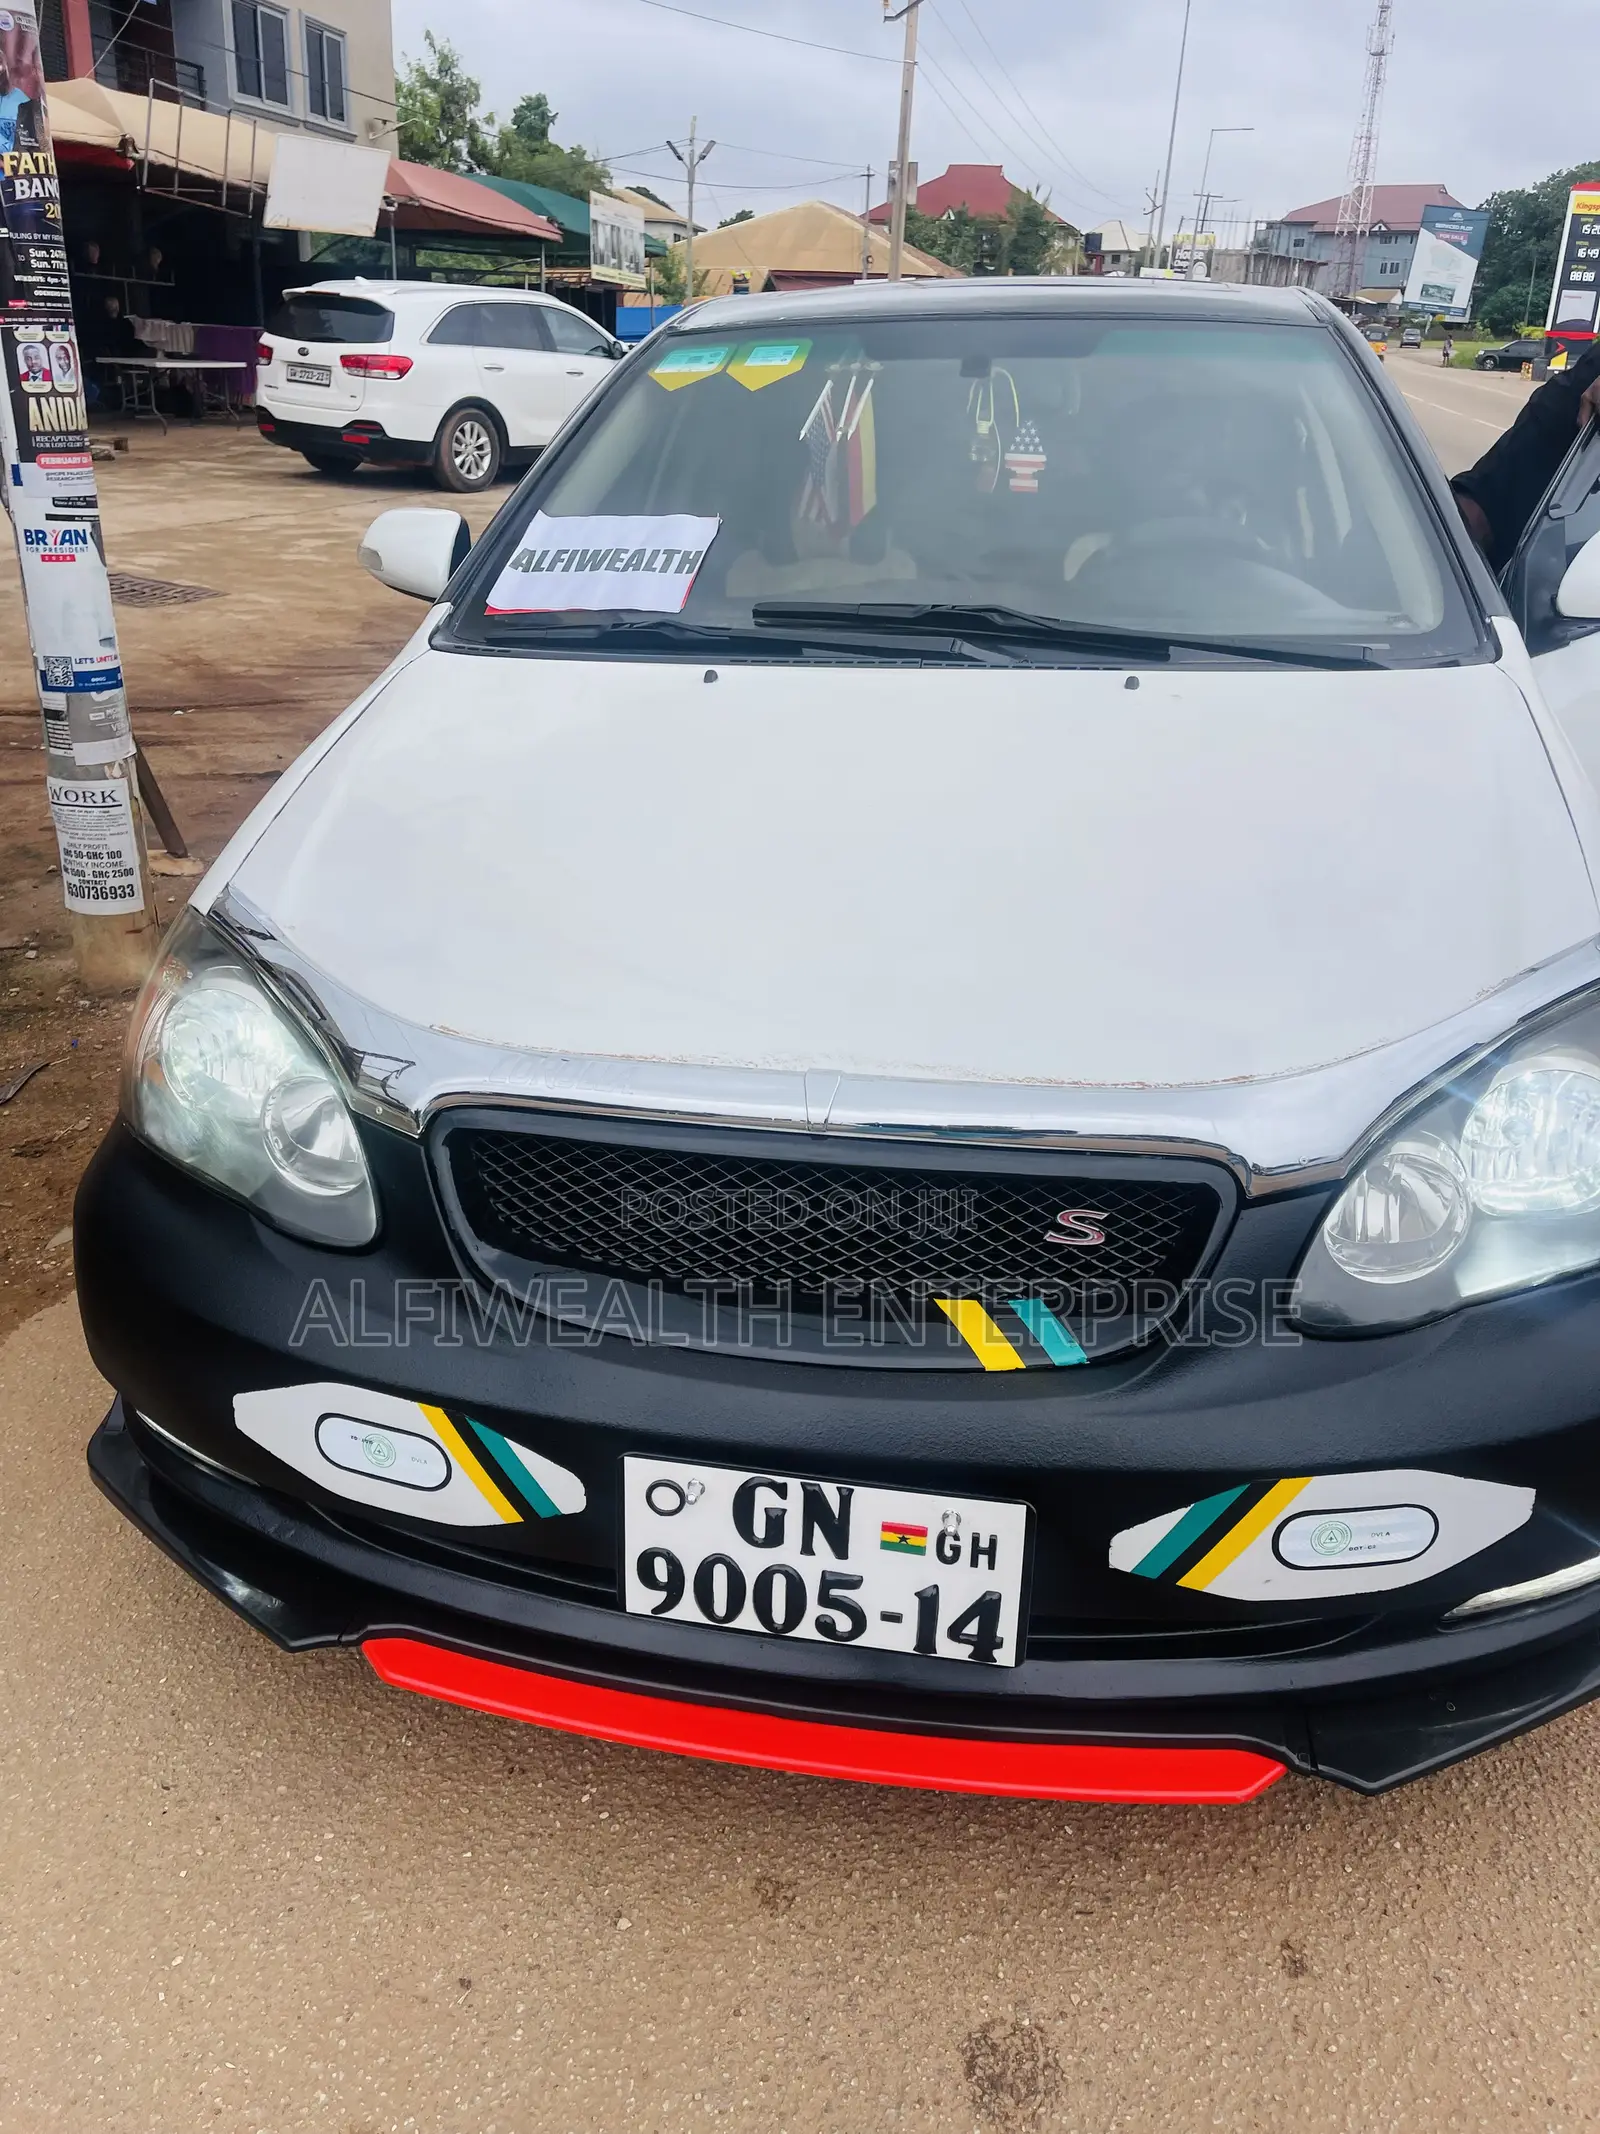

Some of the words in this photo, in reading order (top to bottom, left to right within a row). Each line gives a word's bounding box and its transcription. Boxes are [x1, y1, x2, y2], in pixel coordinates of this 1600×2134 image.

[23, 528, 88, 546] BRYAN
[42, 546, 89, 554] PRESIDENT
[508, 547, 704, 575] ALFIWEALTH
[49, 786, 120, 805] WORK
[105, 850, 122, 860] 100
[111, 867, 135, 878] 2500
[732, 1475, 855, 1560] GN
[935, 1528, 998, 1571] GH
[636, 1546, 1004, 1664] 9005-14
